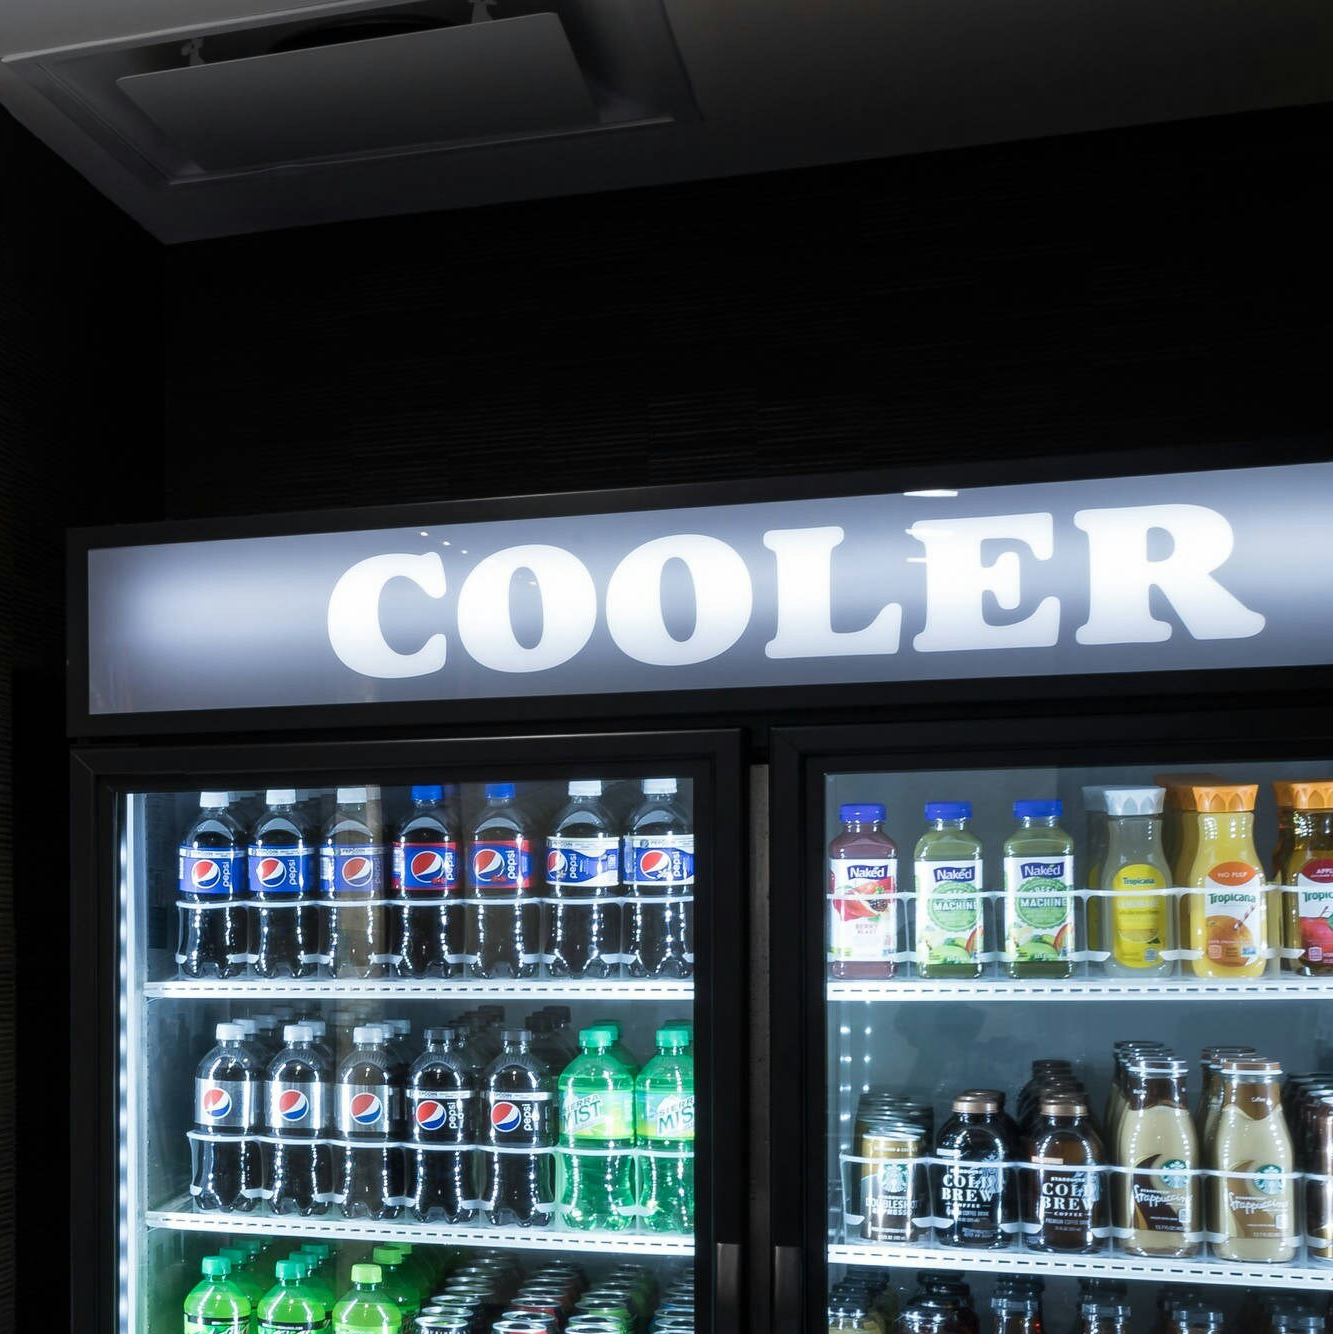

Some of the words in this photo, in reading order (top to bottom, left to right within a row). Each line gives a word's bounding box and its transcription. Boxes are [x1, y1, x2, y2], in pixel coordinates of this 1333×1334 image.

[327, 503, 1266, 678] COOLER
[222, 860, 231, 887] pepsi
[288, 859, 297, 885] pepsi
[506, 850, 517, 879] pepsi
[569, 853, 578, 879] pepsi
[672, 853, 682, 877] pepsi
[1122, 876, 1156, 886] Tropicana
[1021, 899, 1068, 908] MACHINE
[1209, 892, 1258, 904] Tropicana
[448, 1101, 458, 1130] pepsi
[523, 1103, 533, 1132] pepsi
[941, 1187, 994, 1203] BREW
